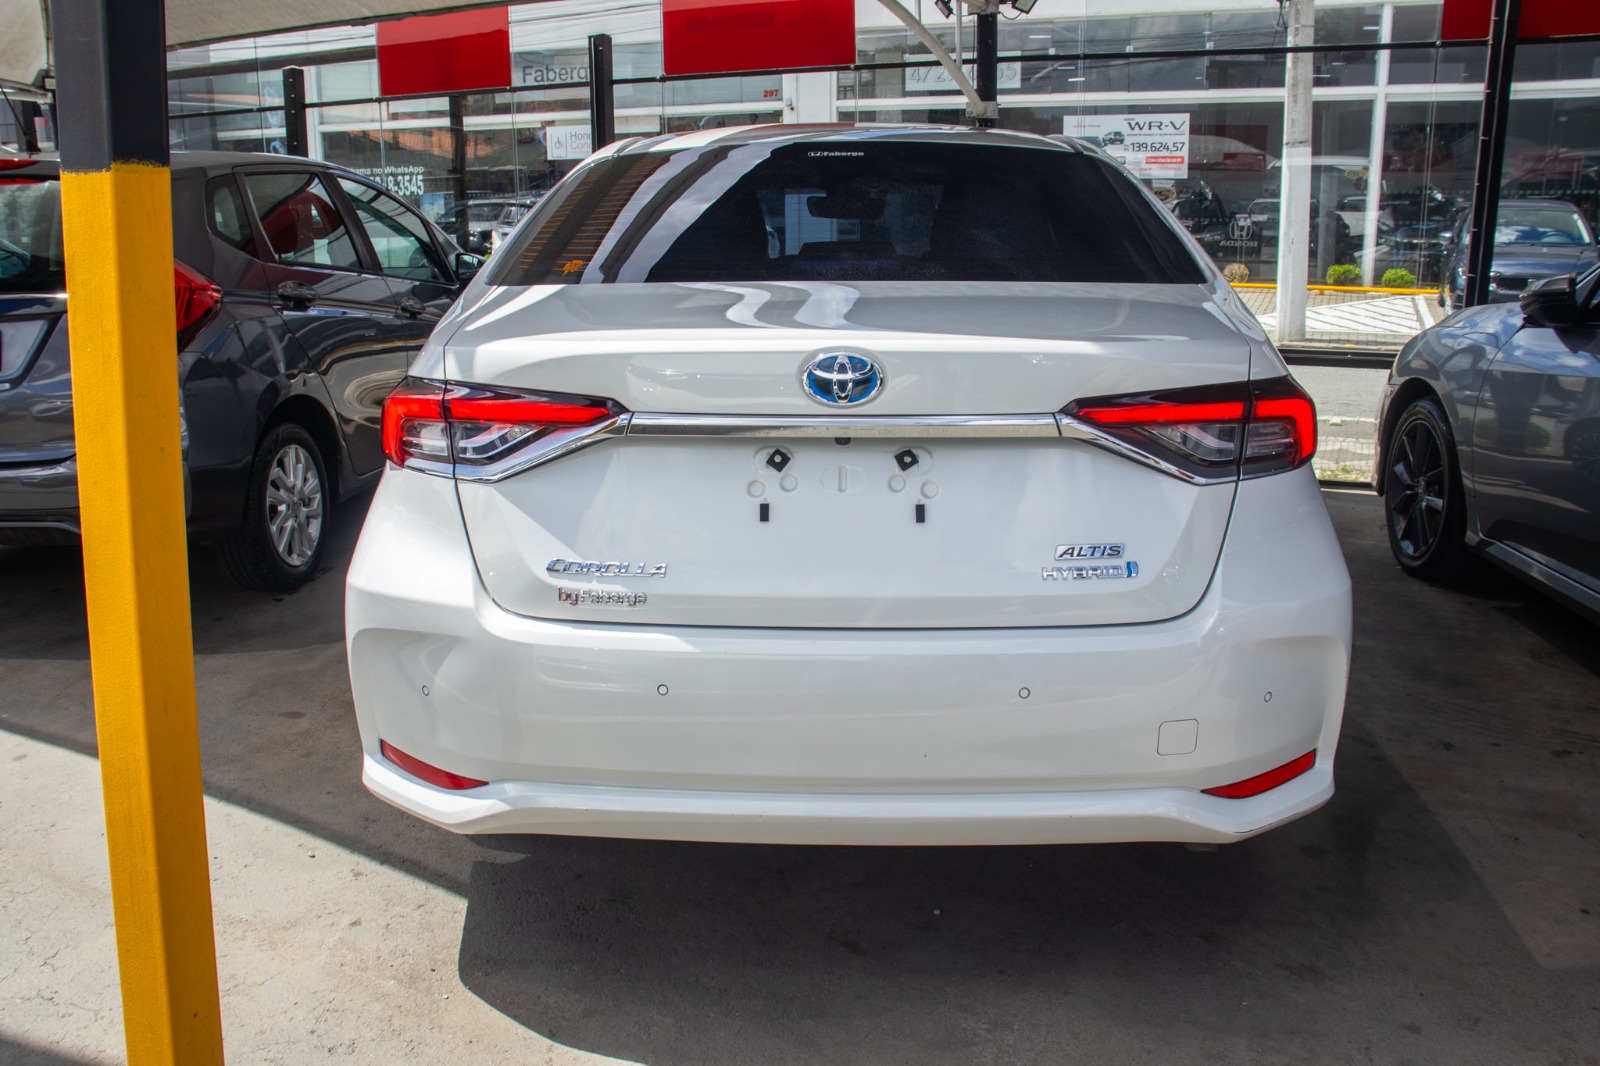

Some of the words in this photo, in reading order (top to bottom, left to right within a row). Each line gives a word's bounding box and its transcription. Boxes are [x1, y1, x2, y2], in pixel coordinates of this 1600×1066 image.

[521, 65, 590, 84] Faberg
[763, 89, 779, 97] 297
[1127, 120, 1186, 131] WR-V
[569, 131, 592, 141] Hon
[1130, 142, 1186, 154] 139.624,57
[384, 165, 424, 174] WhatsApp
[1057, 545, 1121, 558] ALTIS
[546, 559, 668, 578] COROLLA
[1041, 565, 1125, 580] HYBRID
